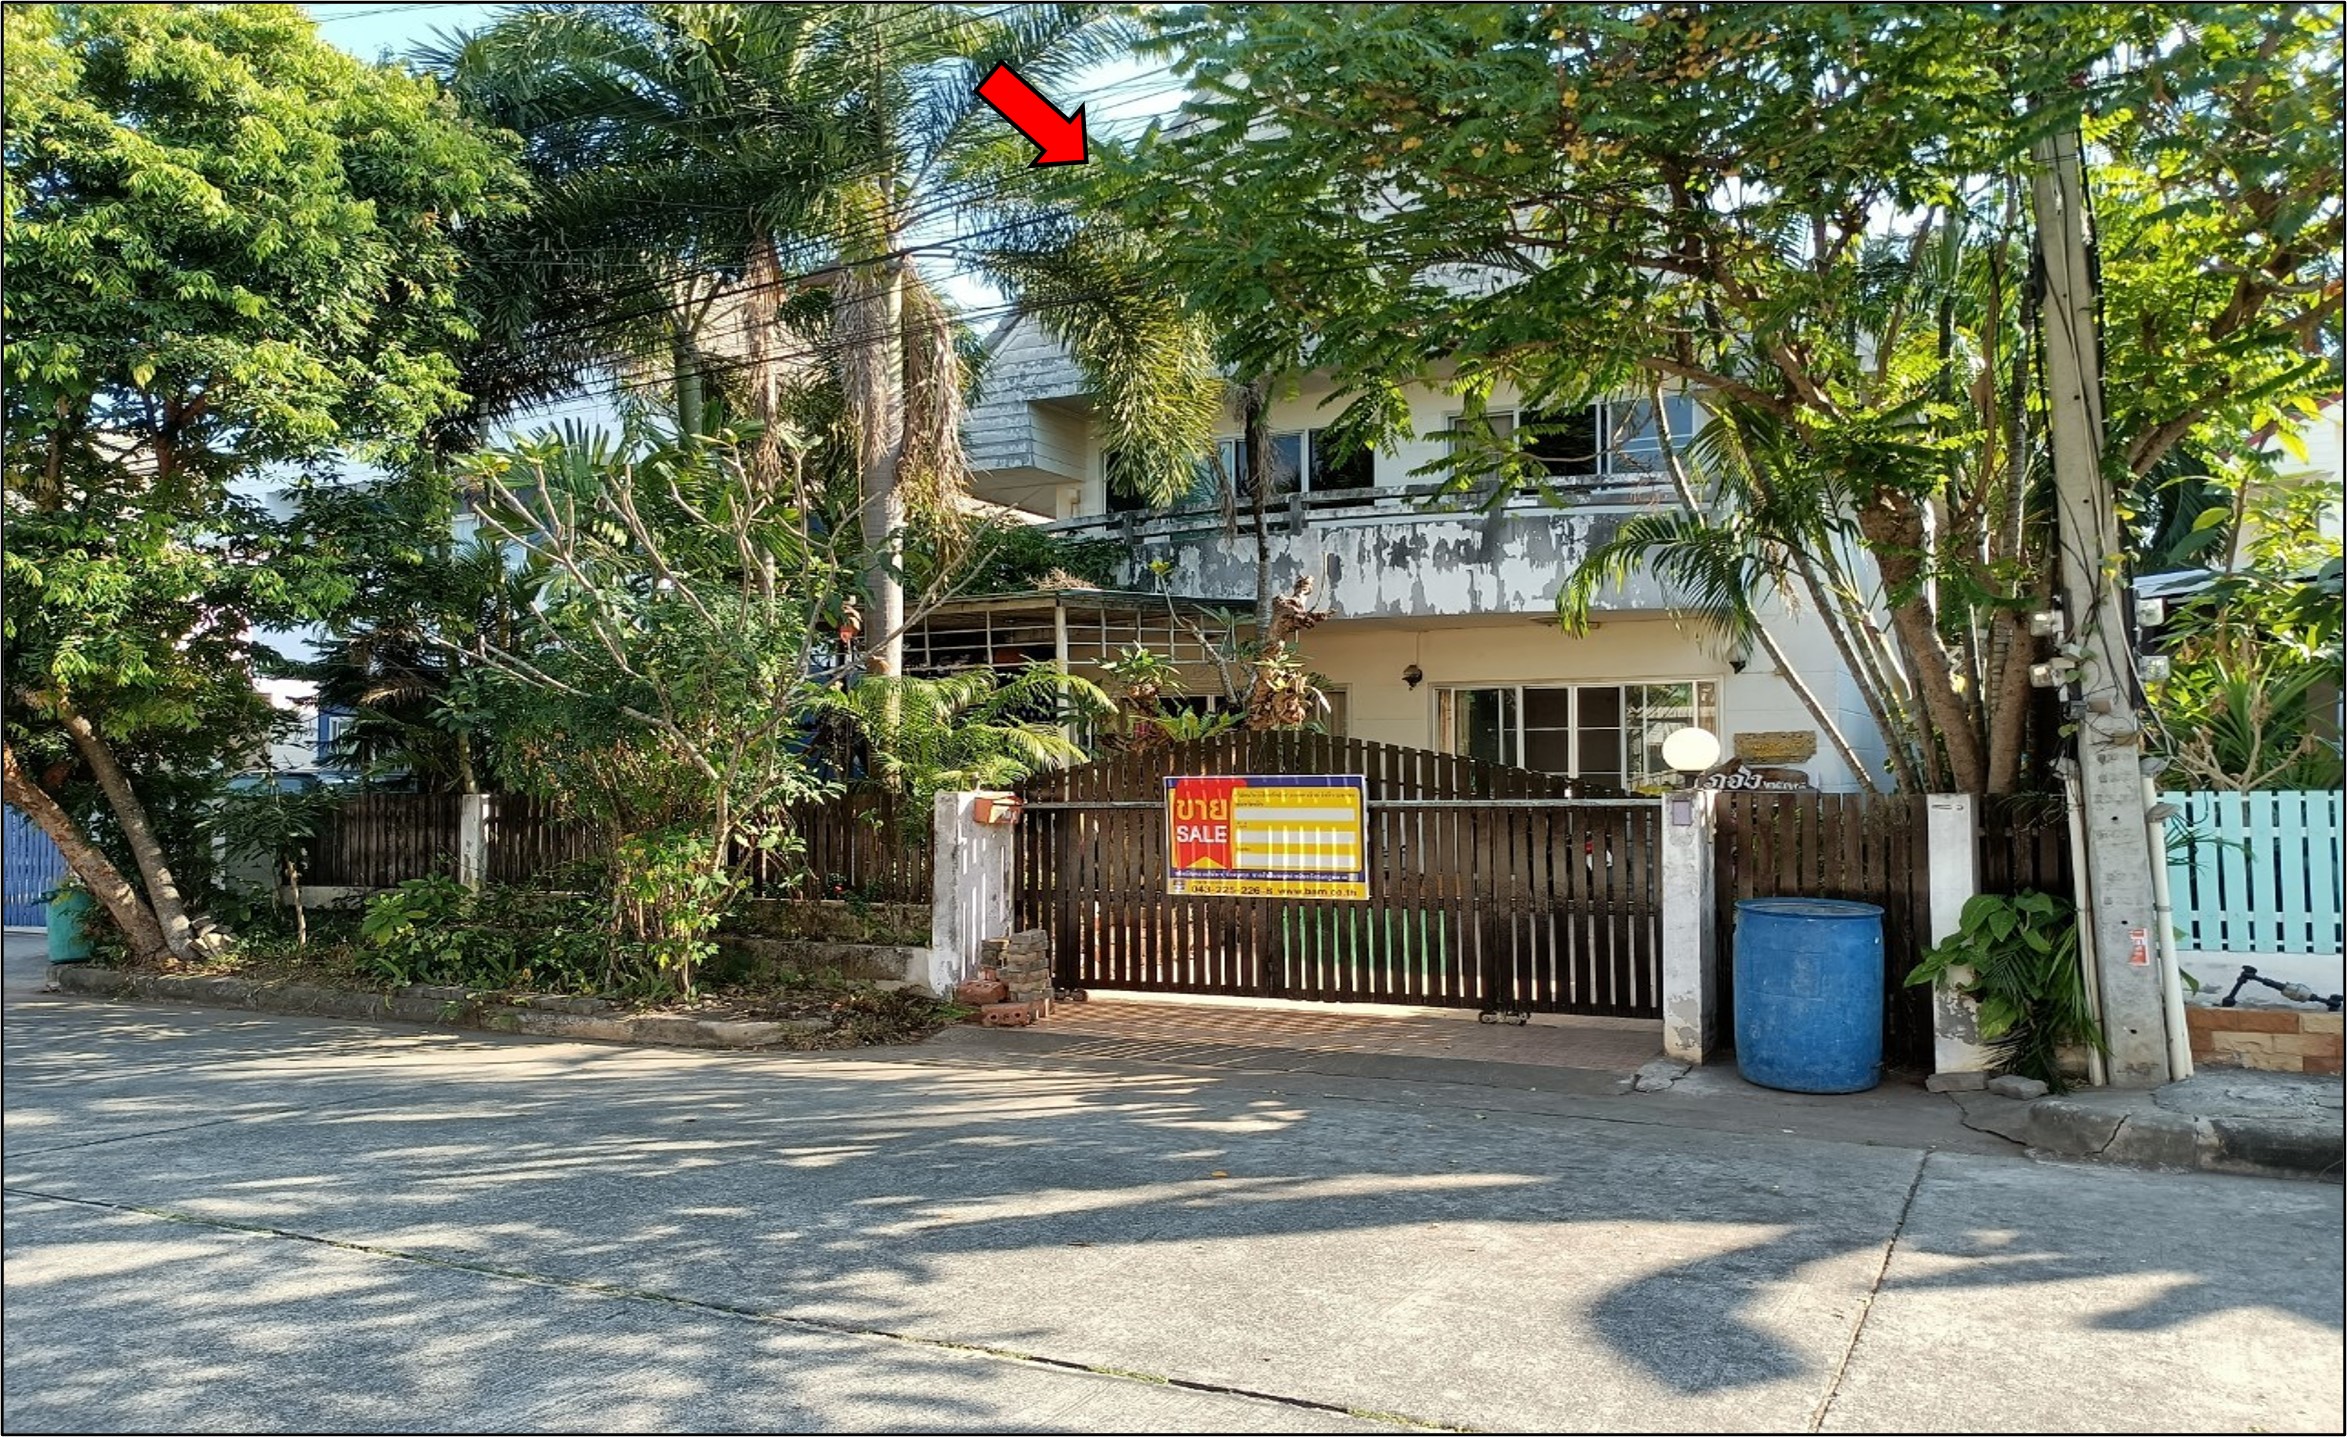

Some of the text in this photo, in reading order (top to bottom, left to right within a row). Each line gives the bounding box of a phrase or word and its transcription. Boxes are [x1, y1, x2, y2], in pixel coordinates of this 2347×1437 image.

[1176, 798, 1228, 820] ขาย
[1176, 825, 1228, 843] SALE
[1277, 887, 1358, 897] www.bam.co.th
